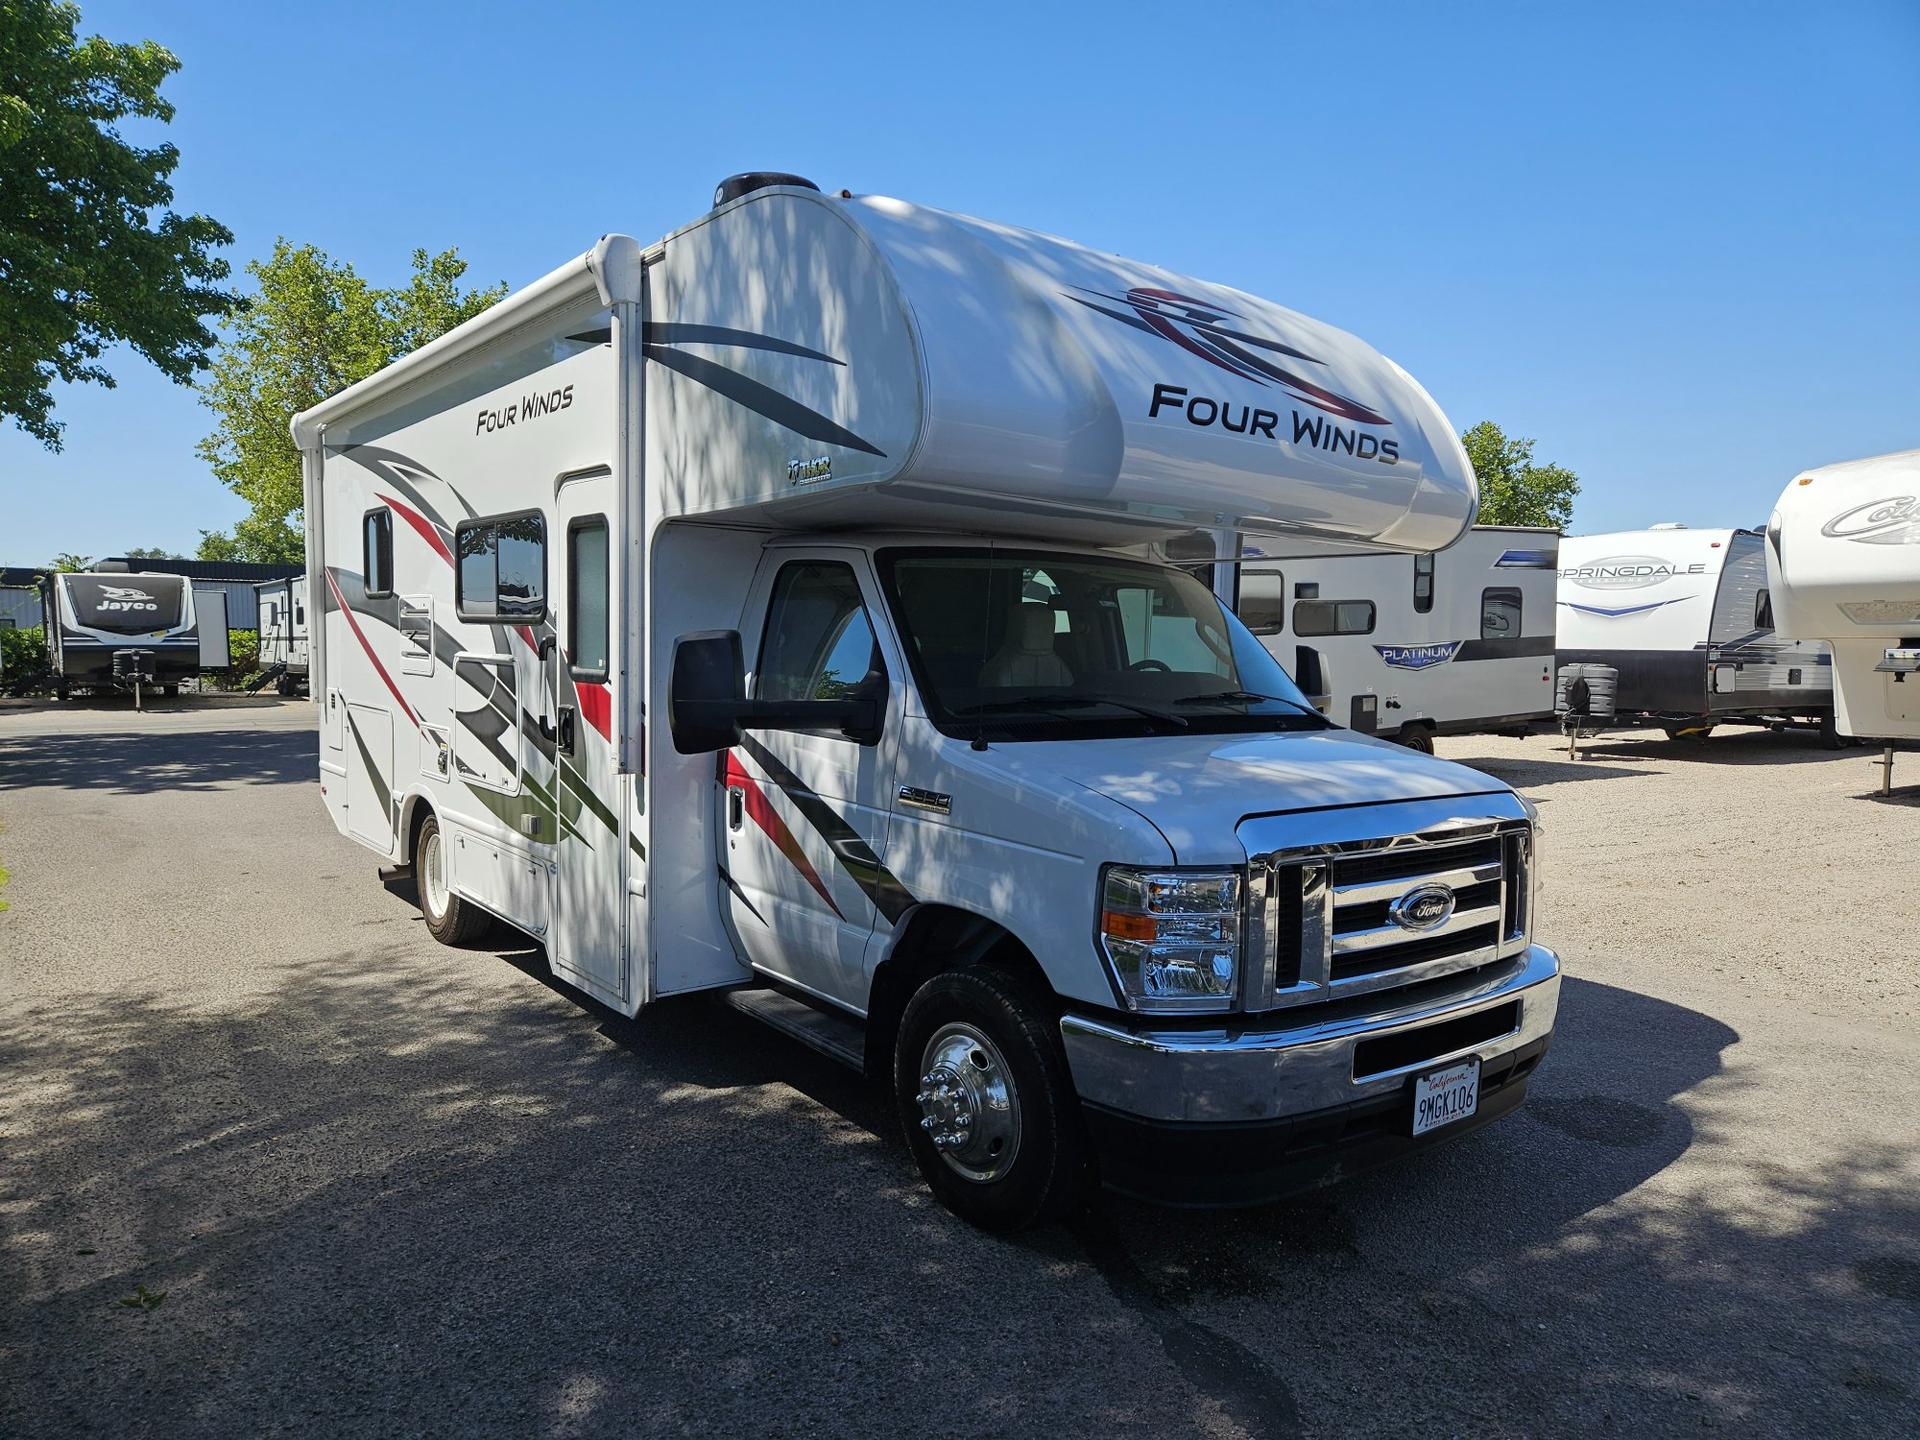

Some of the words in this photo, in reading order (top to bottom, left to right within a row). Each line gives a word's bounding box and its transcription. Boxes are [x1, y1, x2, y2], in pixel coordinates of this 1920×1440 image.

[476, 405, 518, 436] FOUR
[522, 384, 574, 421] WINDS
[1148, 382, 1279, 440] FOUR
[1292, 409, 1400, 466] WINDS
[96, 600, 158, 612] Jayco
[1382, 645, 1453, 660] PLATINUM
[1416, 902, 1444, 917] Ford
[1428, 1073, 1468, 1090] California
[1418, 1081, 1475, 1126] 9MGK106
